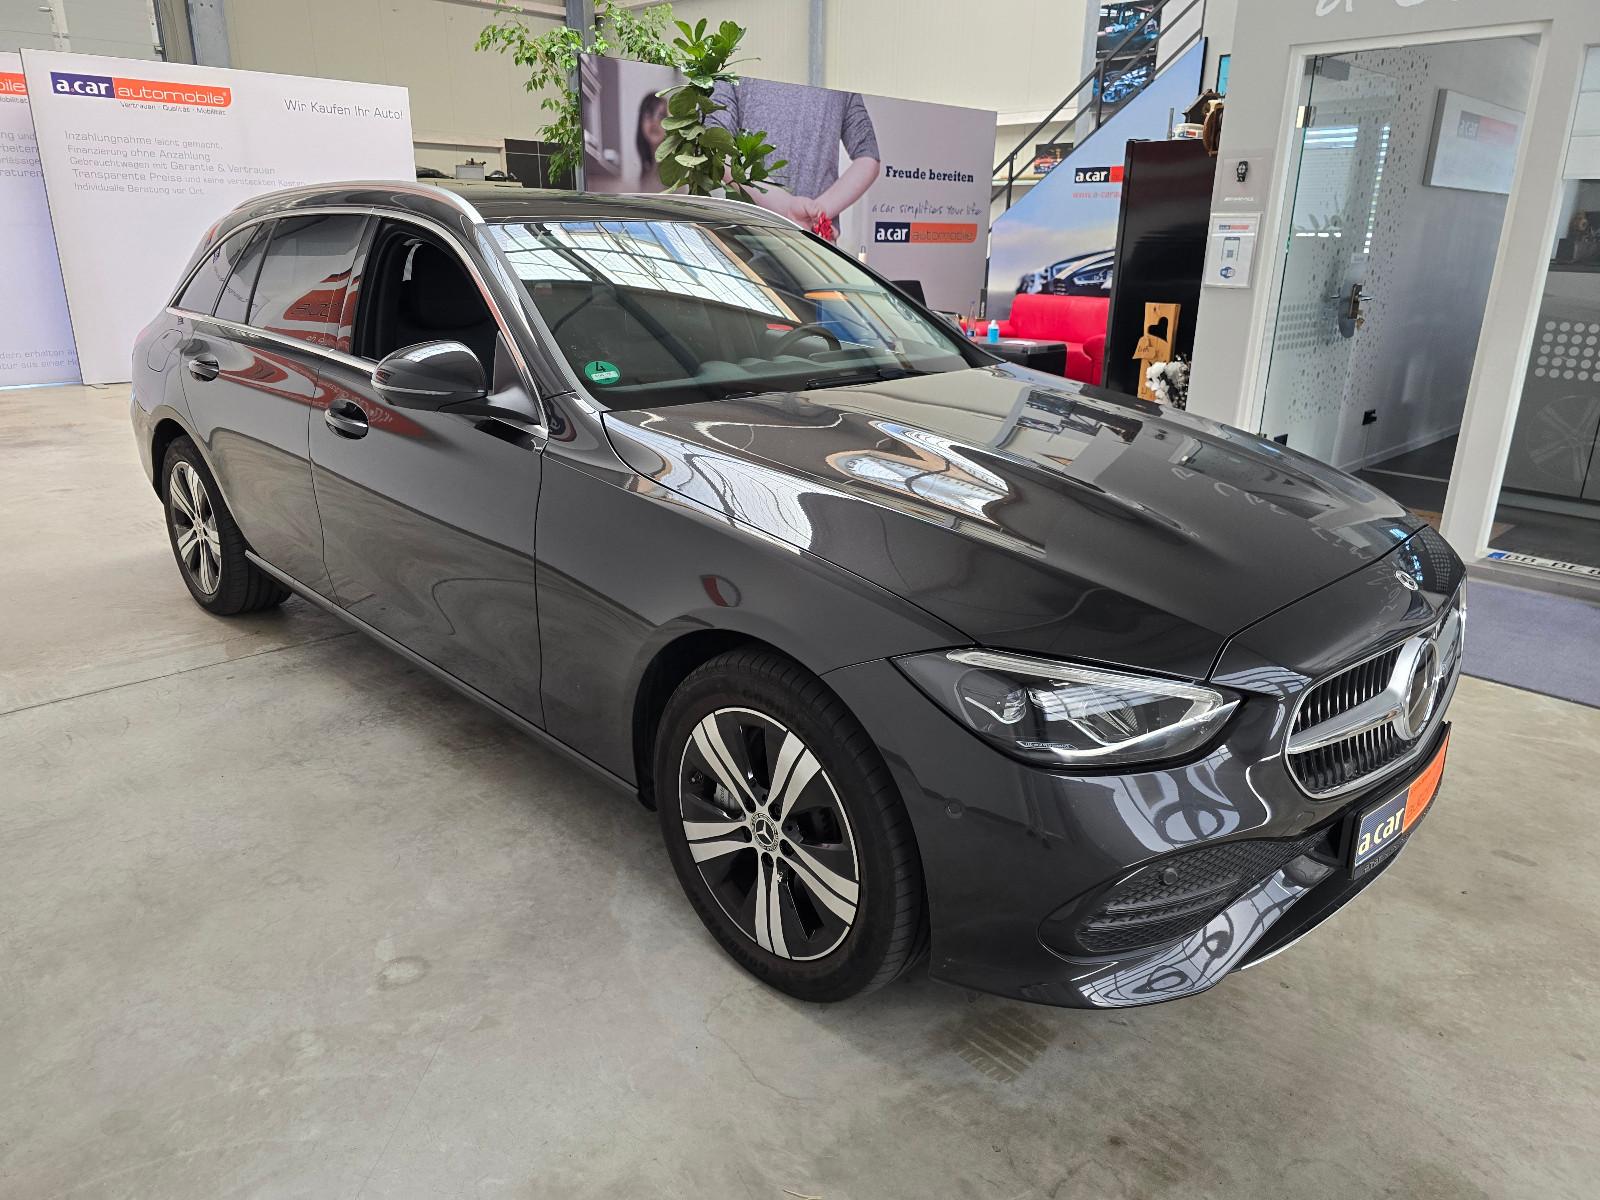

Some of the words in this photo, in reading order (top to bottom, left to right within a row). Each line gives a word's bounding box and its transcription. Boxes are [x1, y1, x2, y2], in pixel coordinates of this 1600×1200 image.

[118, 85, 225, 105] automobile
[284, 99, 307, 112] Wir
[311, 101, 351, 116] Kaufen
[354, 105, 370, 117] Ihr
[374, 107, 403, 120] Auto!
[64, 130, 152, 145] Inzahlungnahme
[67, 145, 128, 158] Finanzierung
[130, 148, 156, 158] ohne
[160, 149, 211, 162] Anzahlung
[70, 156, 150, 170] Gebrauchtwagen
[170, 161, 214, 172] Garantie
[217, 164, 225, 173] &
[227, 164, 276, 175] Vertrauen
[885, 165, 926, 180] Freude
[928, 168, 974, 183] bereiten
[71, 168, 146, 181] Transparente
[149, 172, 182, 183] Preise
